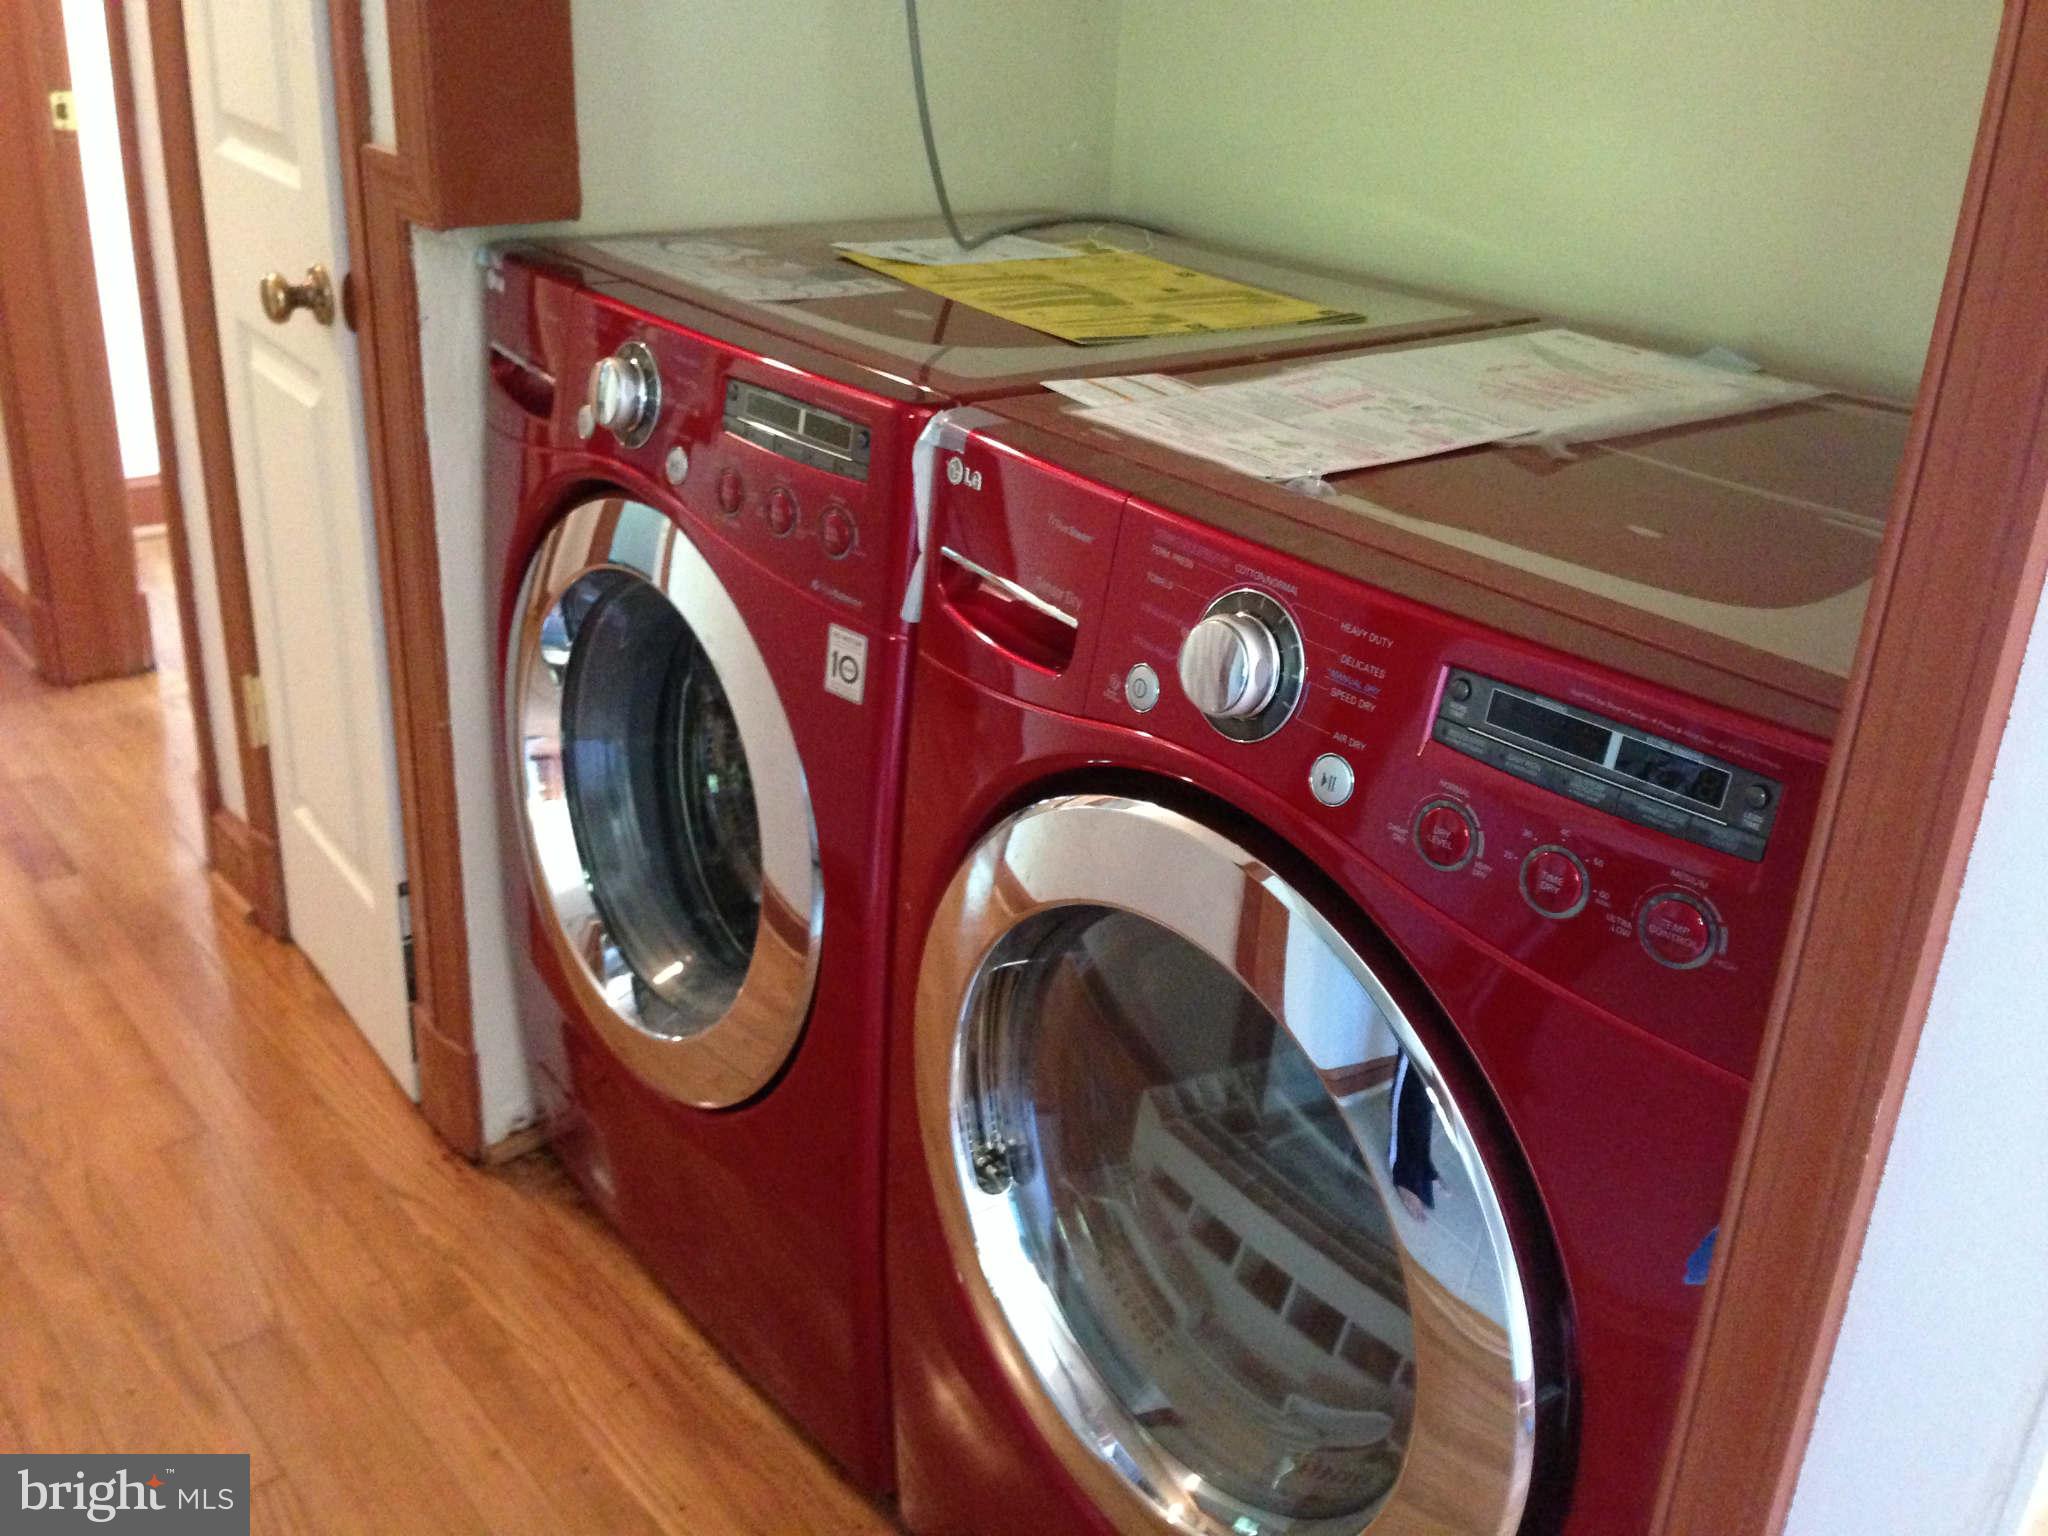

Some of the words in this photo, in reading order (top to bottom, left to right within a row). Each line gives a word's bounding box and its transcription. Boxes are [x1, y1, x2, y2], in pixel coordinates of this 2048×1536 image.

[1341, 622, 1368, 639] HEAVY
[1369, 633, 1394, 648] DUTY
[1341, 654, 1387, 679] DELICATES
[1330, 688, 1357, 705] SPEED
[1358, 698, 1376, 712] DRY
[1333, 732, 1347, 744] AIR
[1348, 737, 1366, 750] DRY
